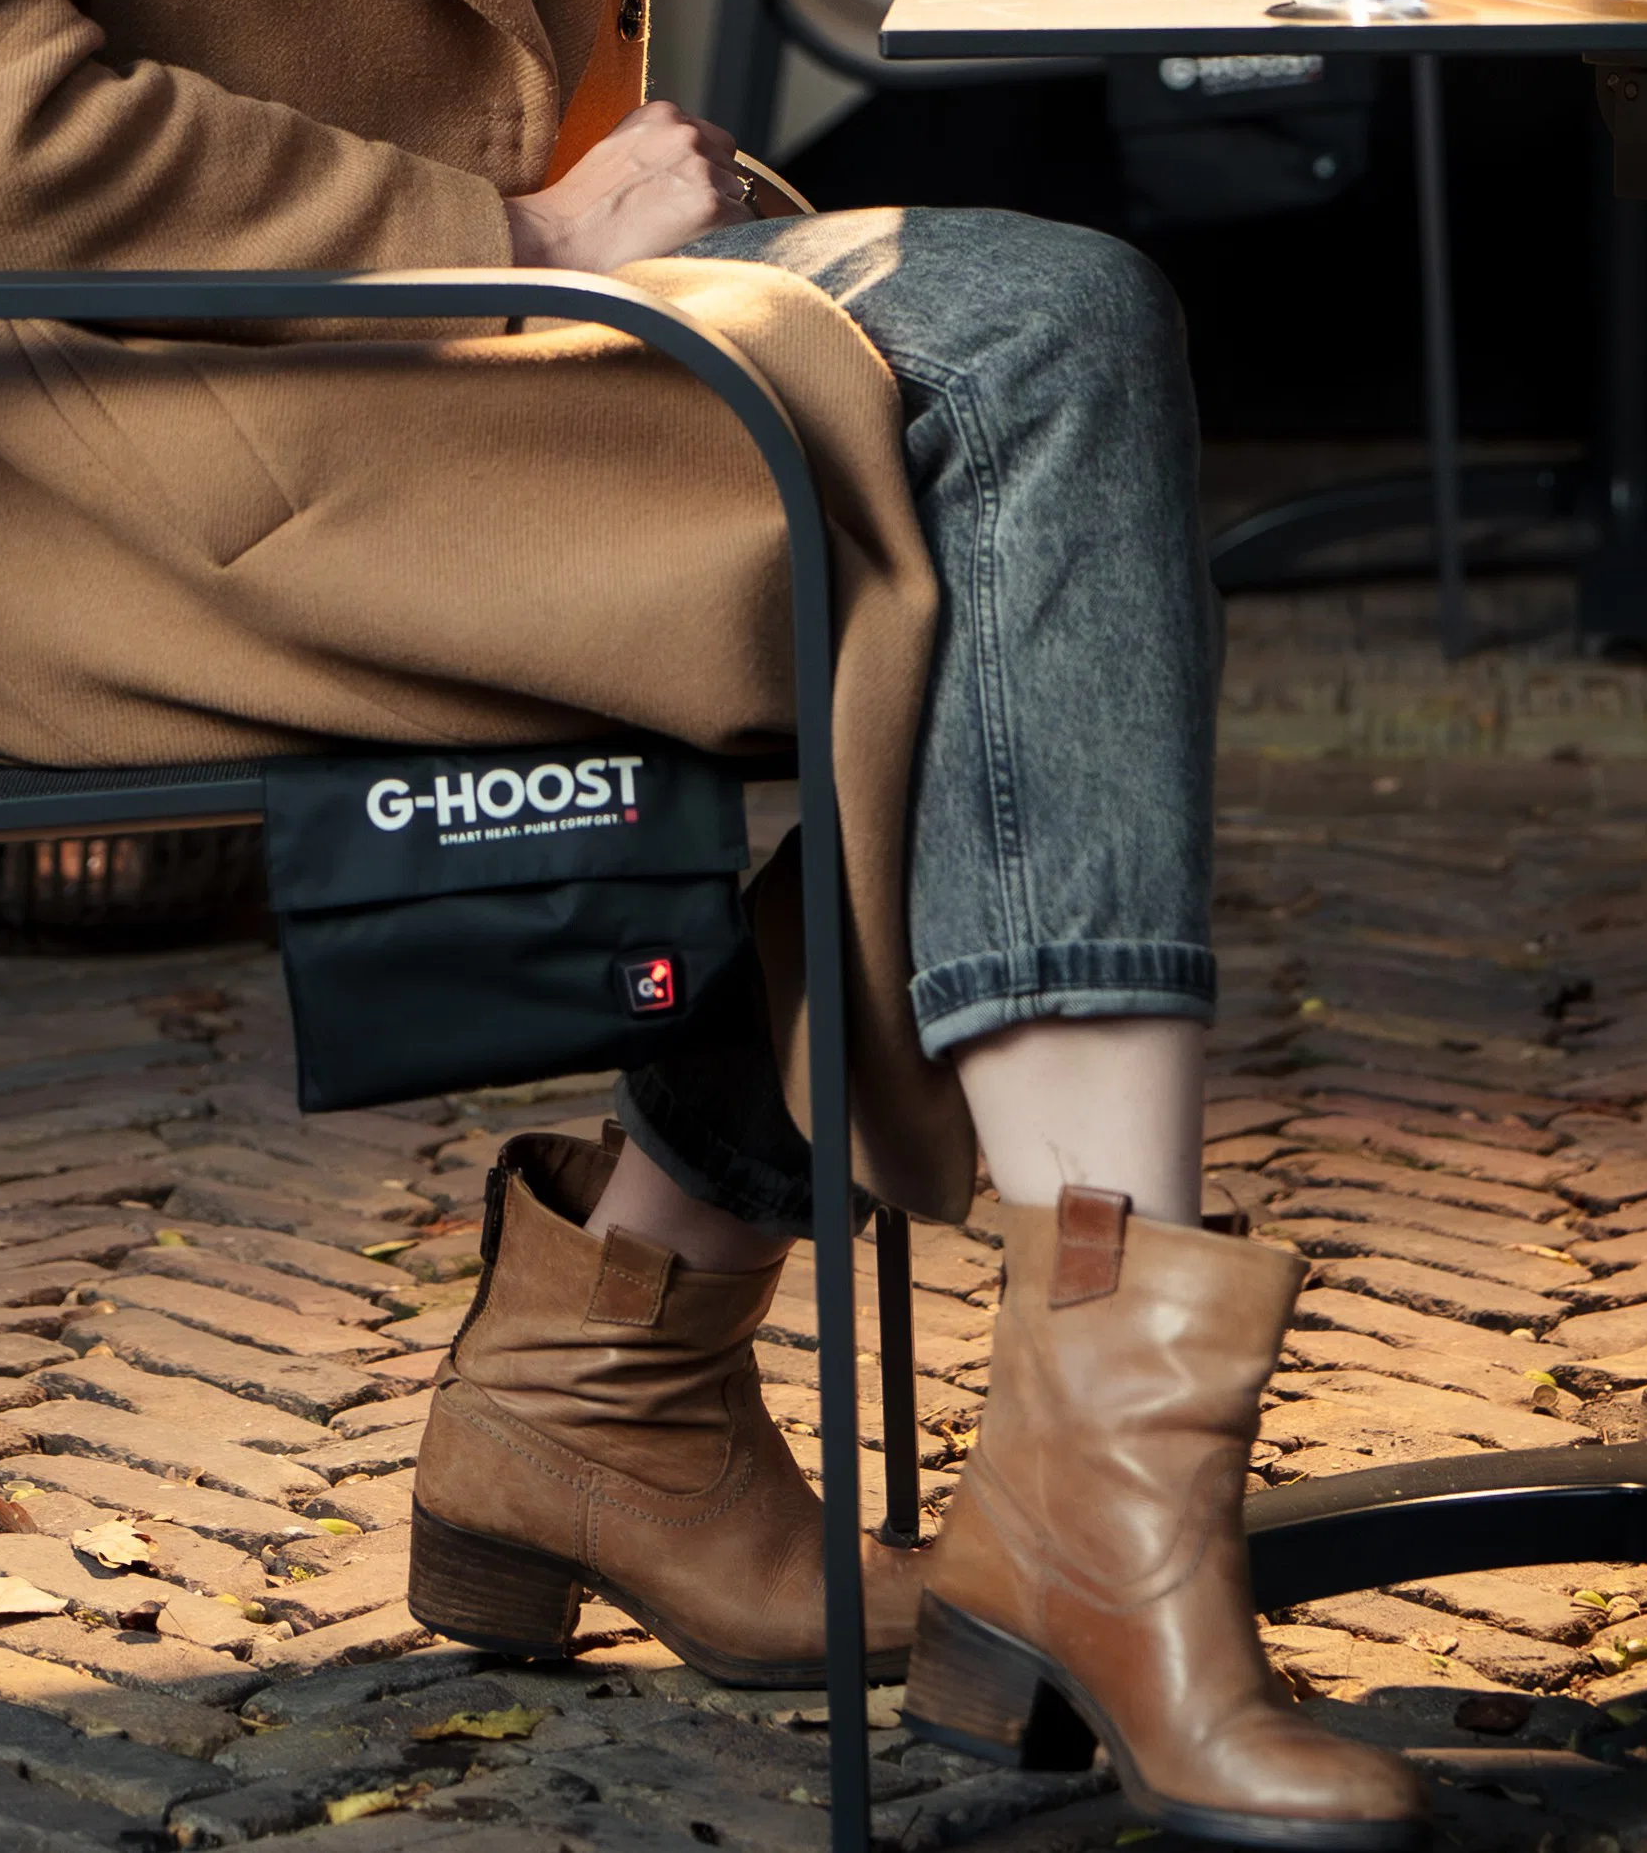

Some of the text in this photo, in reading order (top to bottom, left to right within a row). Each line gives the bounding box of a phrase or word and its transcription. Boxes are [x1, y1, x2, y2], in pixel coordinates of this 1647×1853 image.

[366, 755, 643, 831] G-HOOST
[439, 830, 482, 845] SMART
[524, 820, 557, 835] PURE
